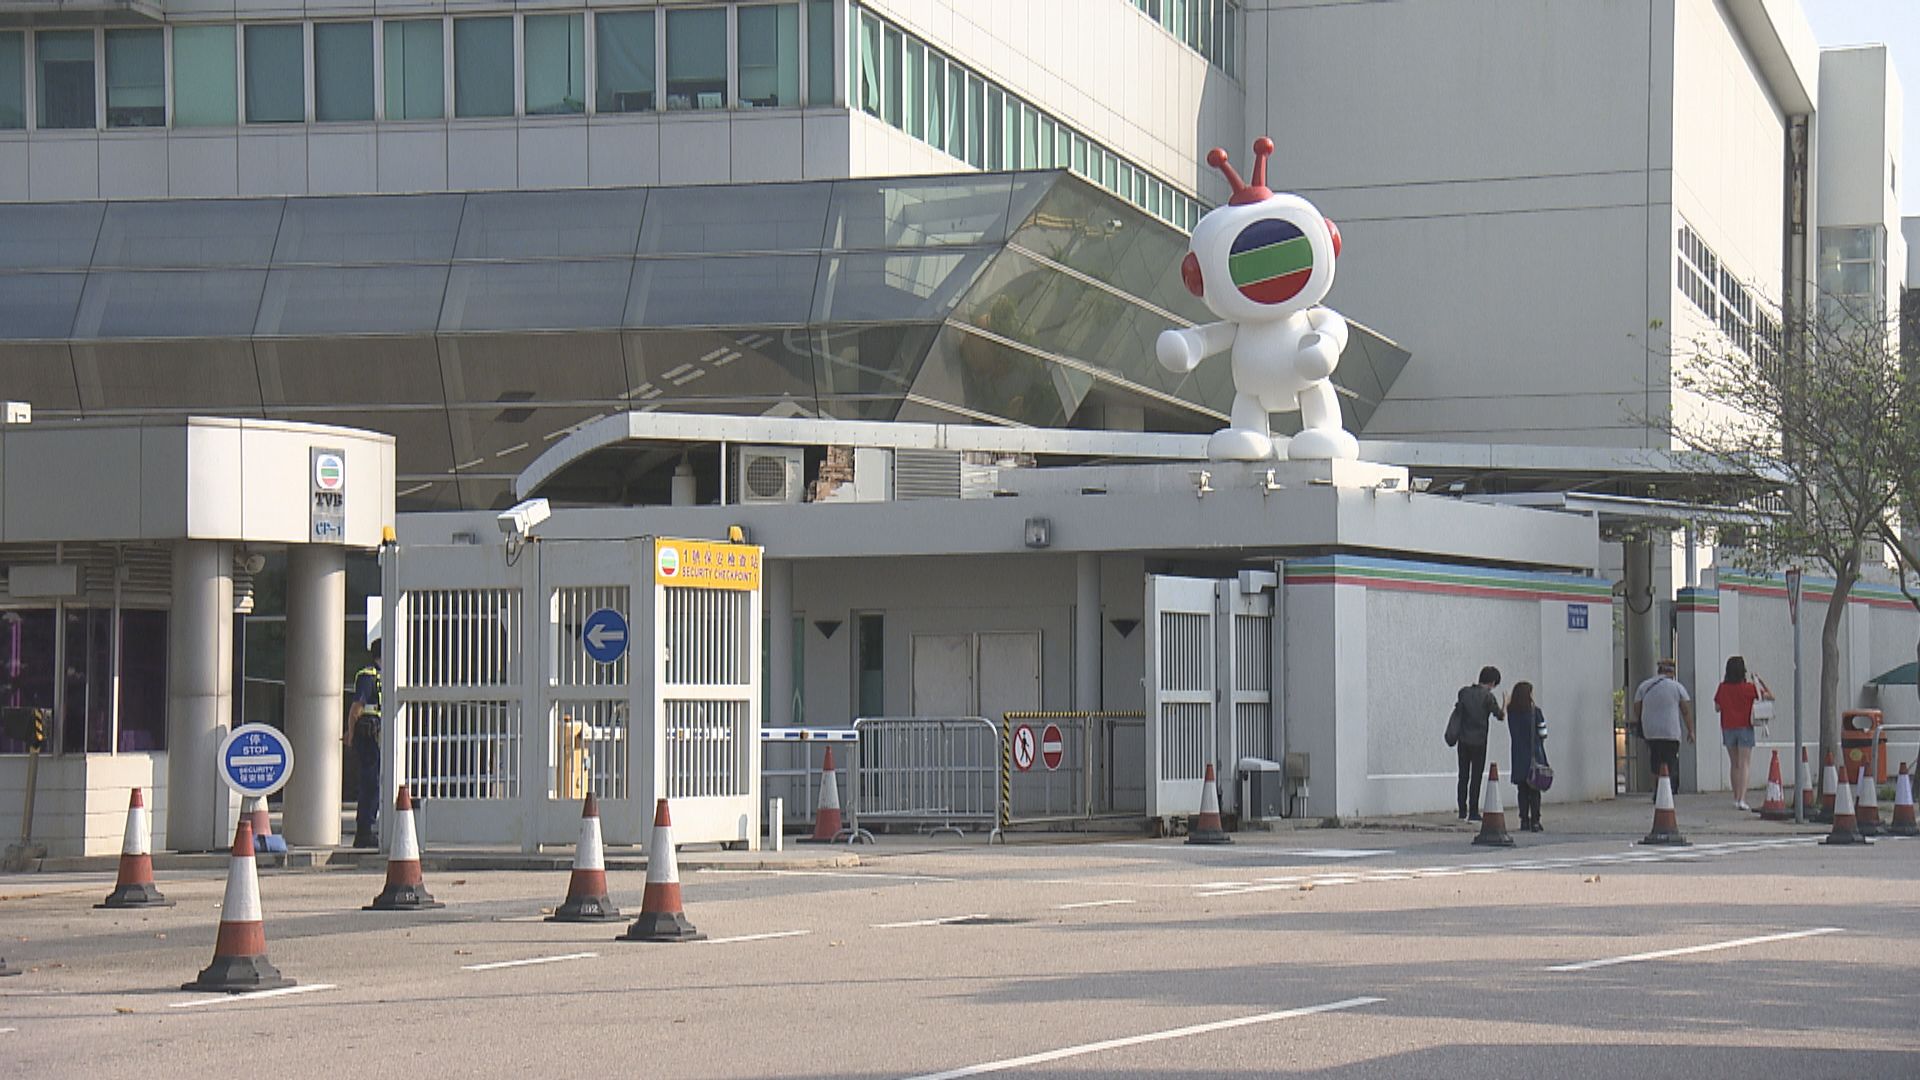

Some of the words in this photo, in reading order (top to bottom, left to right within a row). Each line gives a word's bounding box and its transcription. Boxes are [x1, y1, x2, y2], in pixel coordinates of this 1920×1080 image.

[315, 491, 343, 508] TVB
[682, 566, 712, 580] SECURITY
[714, 568, 752, 582] CHECKPOINT
[242, 745, 269, 756] STOP
[239, 766, 274, 774] SECURITY
